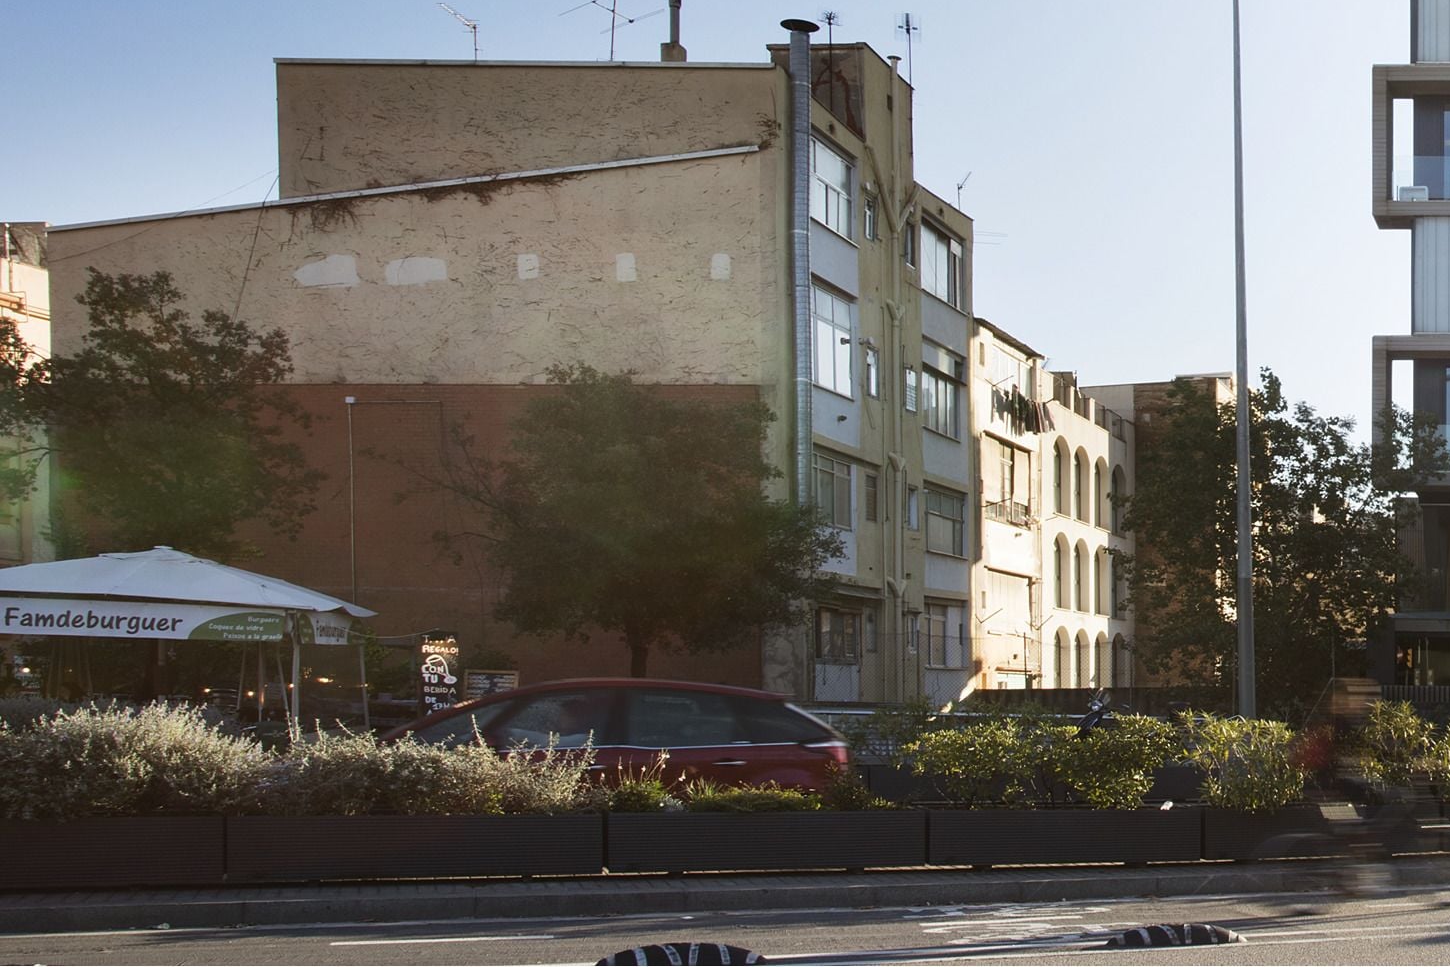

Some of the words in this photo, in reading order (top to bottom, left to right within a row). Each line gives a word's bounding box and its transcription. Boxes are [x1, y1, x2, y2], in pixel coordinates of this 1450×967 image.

[4, 607, 183, 634] Famdeburguer
[421, 644, 459, 656] REGALO!
[421, 664, 444, 674] CON
[422, 673, 439, 684] TU
[425, 696, 437, 704] DE
